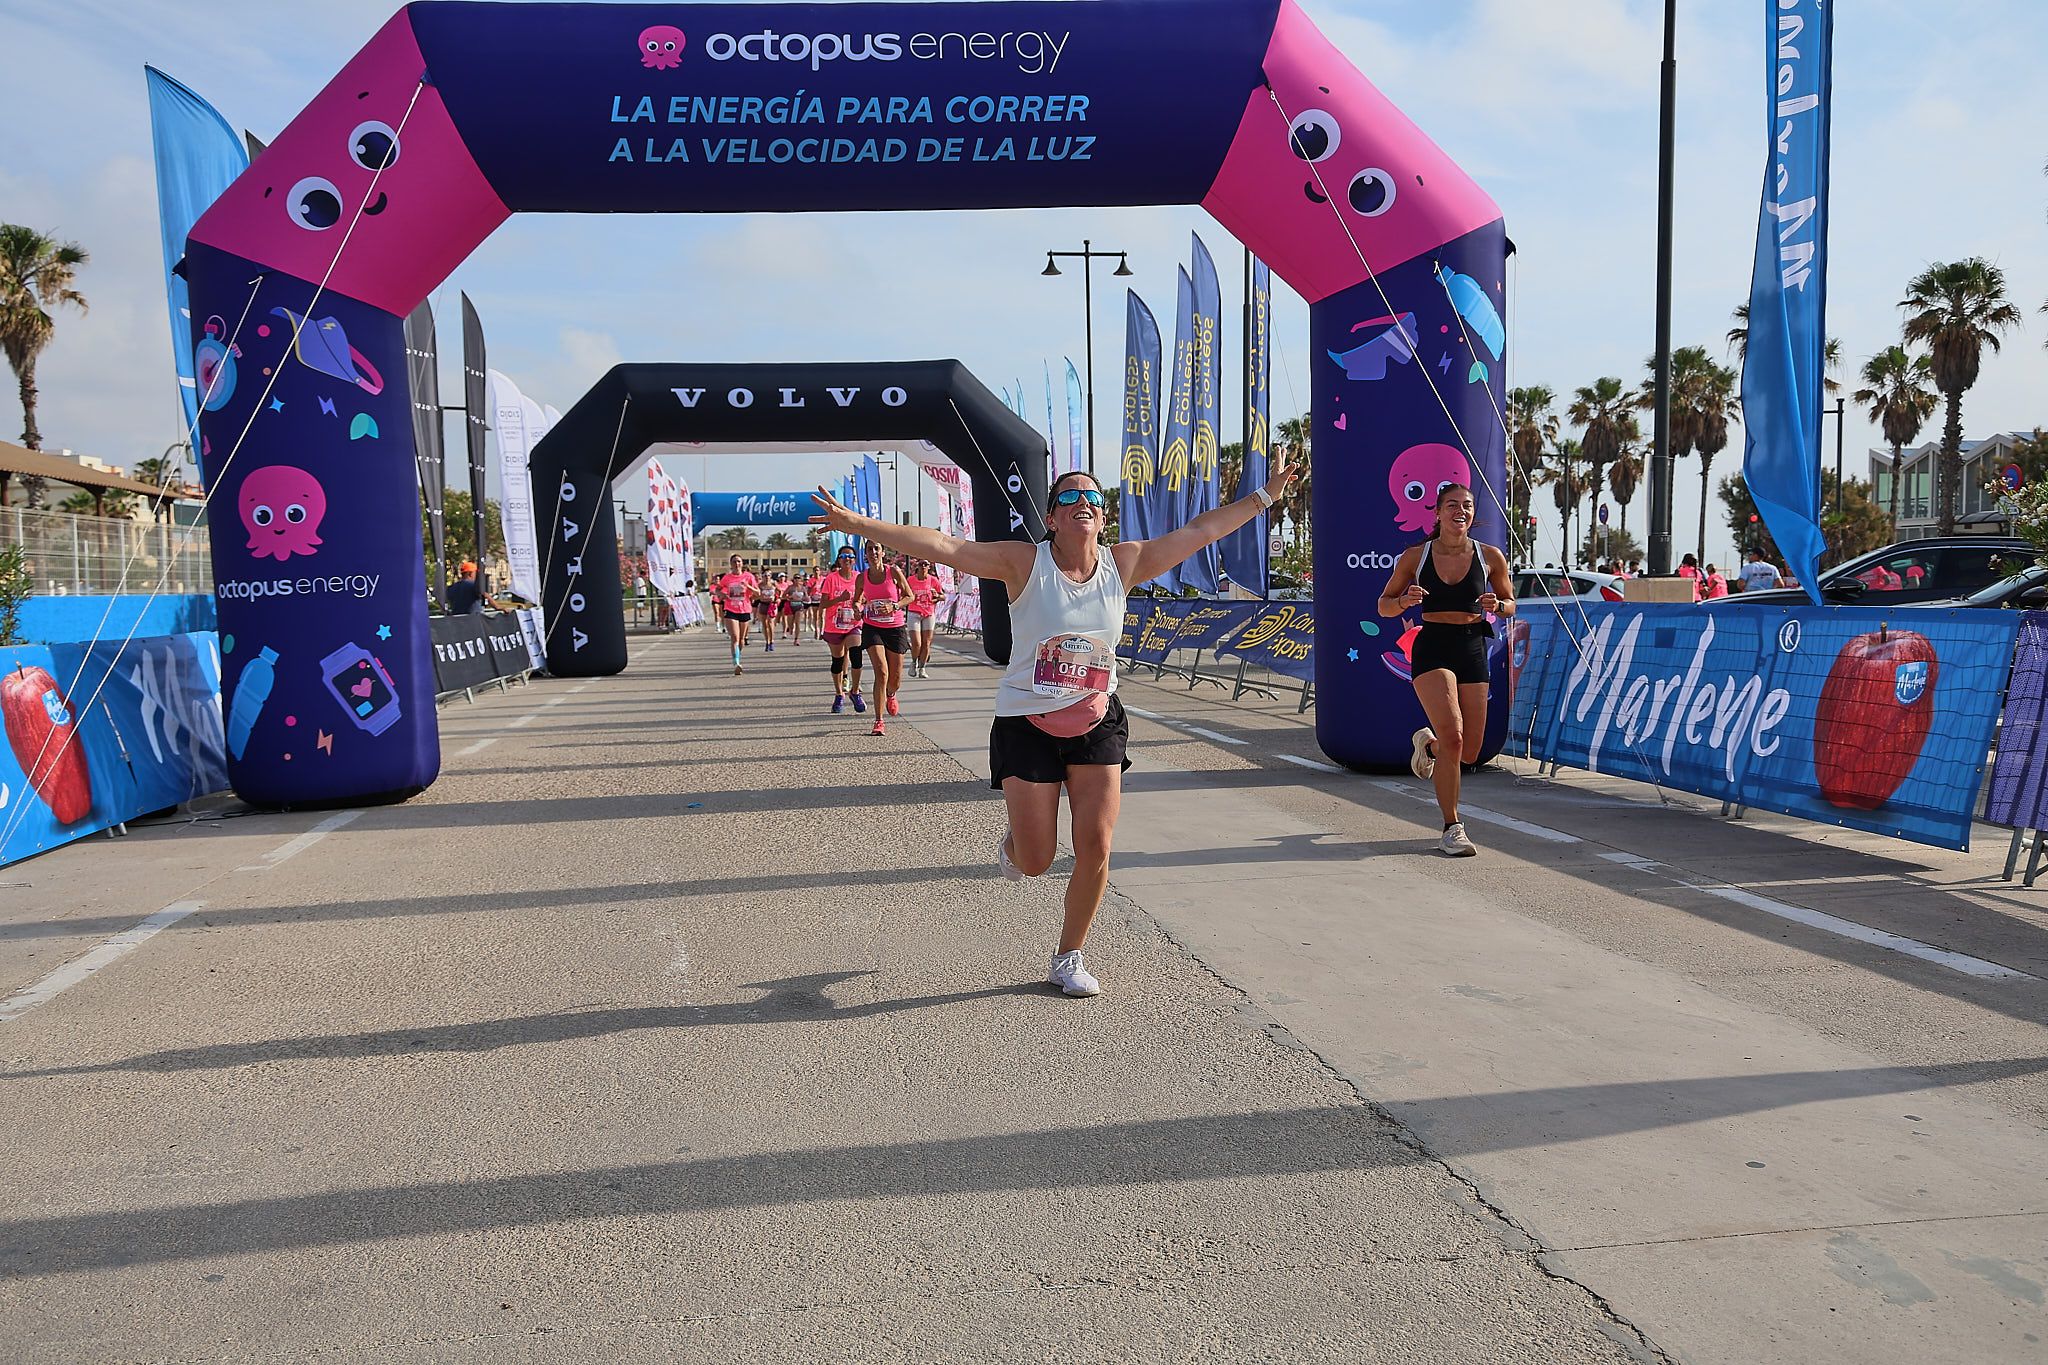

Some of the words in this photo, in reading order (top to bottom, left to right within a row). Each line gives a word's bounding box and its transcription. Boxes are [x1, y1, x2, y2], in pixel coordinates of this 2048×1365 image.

[705, 30, 902, 71] octopus
[909, 31, 1071, 74] energy
[609, 96, 656, 124] LA
[667, 89, 823, 125] ENERGÍA
[836, 95, 934, 124] PARA
[944, 94, 1091, 123] CORRER
[608, 138, 635, 163] A
[644, 138, 690, 163] LA
[702, 138, 908, 164] VELOCIDAD
[916, 138, 965, 163] DE
[971, 137, 1017, 162] LA
[1026, 136, 1097, 162] LUZ
[670, 386, 908, 408] VOLVO
[736, 494, 796, 522] Marlene
[560, 482, 590, 652] VOLVO
[218, 580, 294, 602] octopus
[295, 574, 380, 598] energy
[434, 637, 487, 662] VOLVO
[1058, 662, 1088, 677] 016
[1559, 612, 1791, 783] Marlene
